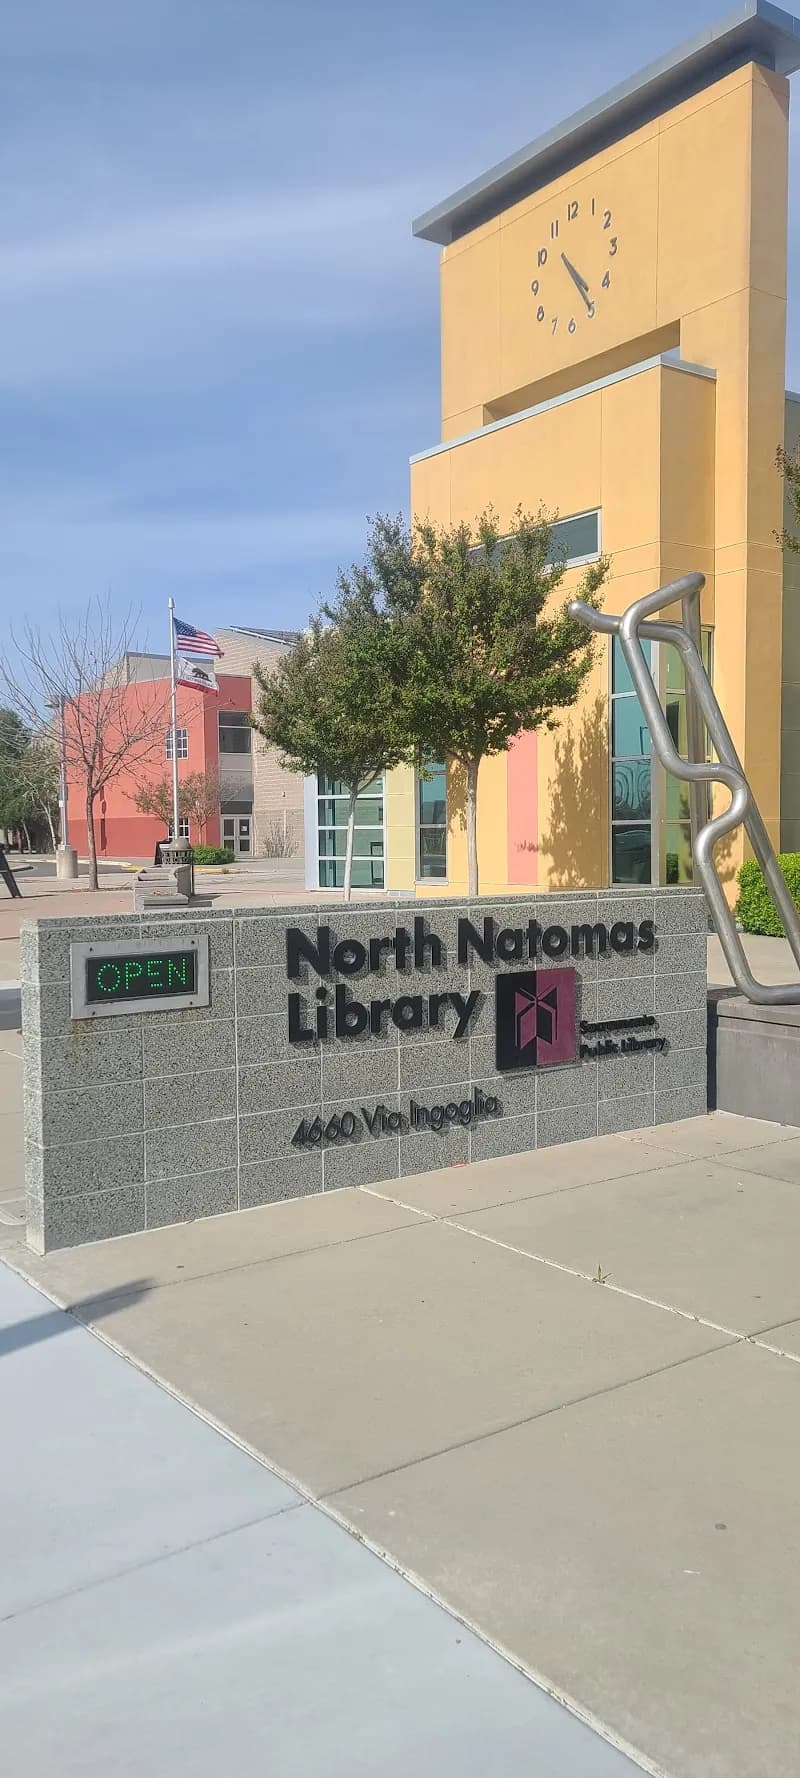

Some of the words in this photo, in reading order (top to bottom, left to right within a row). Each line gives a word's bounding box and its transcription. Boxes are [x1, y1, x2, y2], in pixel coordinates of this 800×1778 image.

[567, 201, 579, 221] 12
[603, 210, 612, 230] 2
[551, 219, 559, 239] 11
[609, 237, 618, 256] 3
[537, 248, 548, 267] 10
[531, 279, 539, 296] 9
[602, 270, 611, 289] 4
[536, 305, 545, 322] 8
[587, 300, 595, 319] 5
[551, 317, 558, 336] 7
[568, 317, 576, 334] 6
[286, 916, 442, 980] North
[458, 917, 656, 964] Natomas
[97, 958, 187, 992] OPEN
[288, 984, 481, 1043] Library
[580, 1039, 619, 1058] Public
[620, 1037, 666, 1053] Library
[290, 1111, 356, 1145] 4660
[361, 1104, 402, 1137] Via
[409, 1086, 499, 1131] Ingoglia
